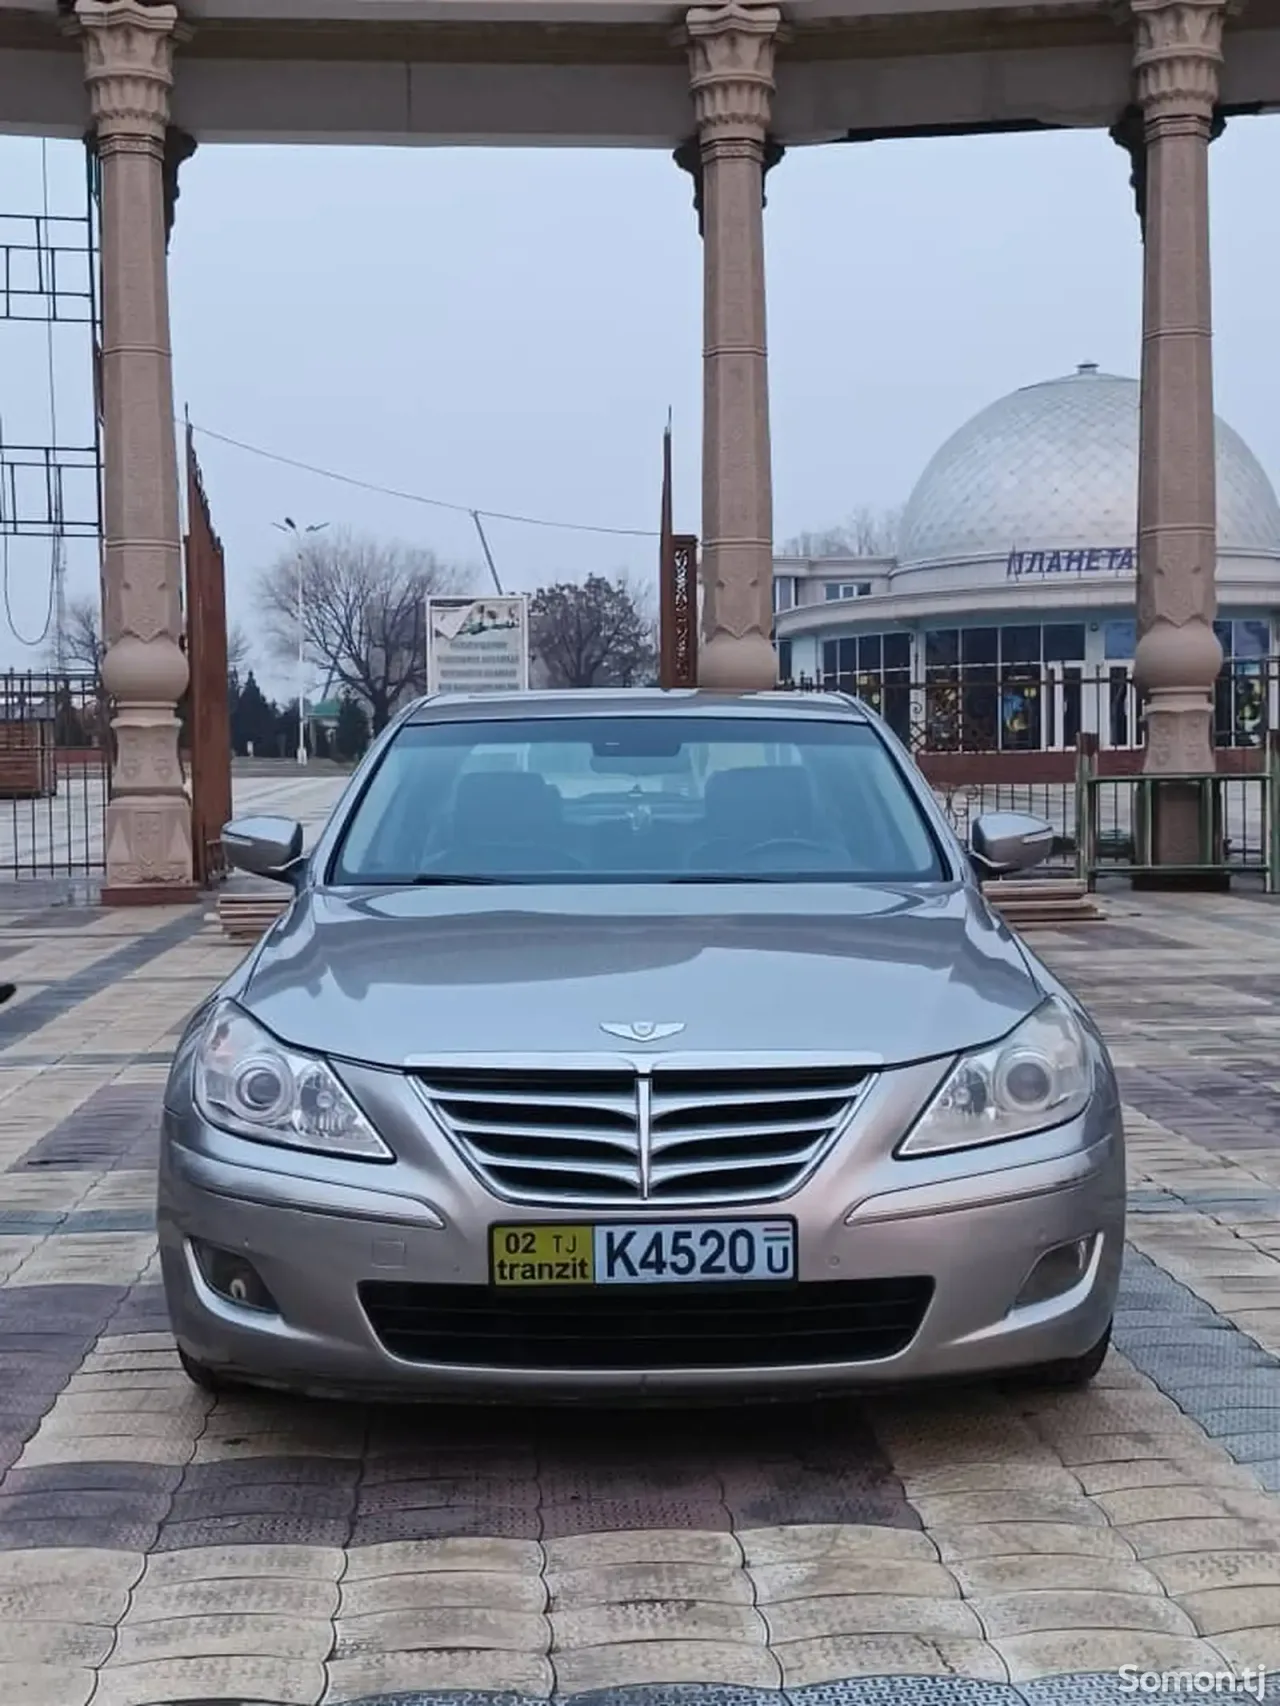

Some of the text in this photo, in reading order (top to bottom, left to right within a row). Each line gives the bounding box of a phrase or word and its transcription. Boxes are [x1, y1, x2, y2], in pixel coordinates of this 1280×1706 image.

[1006, 547, 1133, 577] ПЛАНЕТА
[505, 1232, 577, 1255] 02 TJ
[605, 1227, 756, 1278] K4520
[496, 1256, 589, 1281] tranzit
